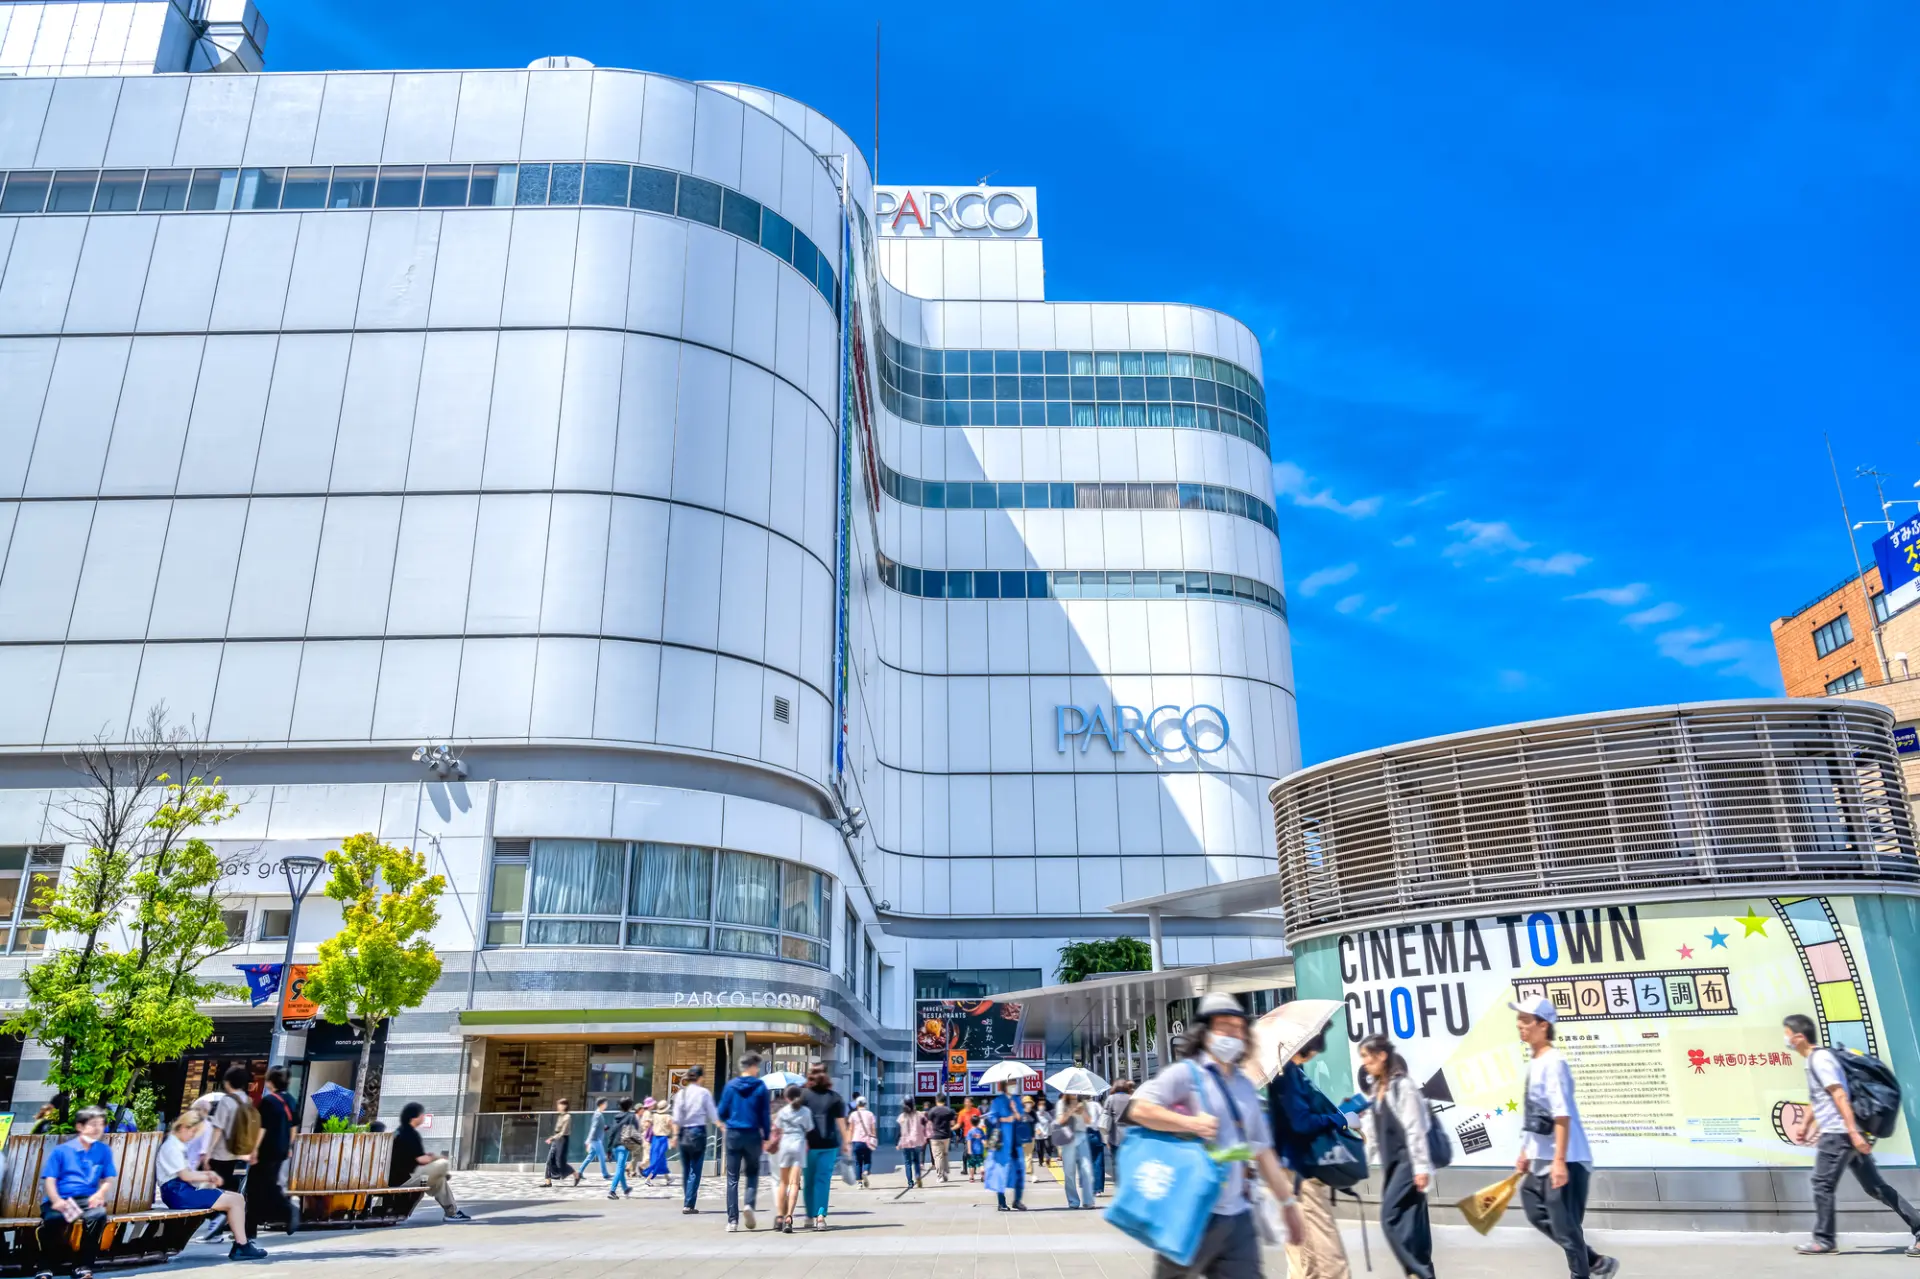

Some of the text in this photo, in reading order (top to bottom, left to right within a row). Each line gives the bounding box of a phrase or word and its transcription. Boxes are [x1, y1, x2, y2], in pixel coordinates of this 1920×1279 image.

[873, 189, 1028, 232] PARCO
[1055, 703, 1230, 756] PARCO
[1338, 905, 1646, 984] CINEMA TOWN
[674, 991, 745, 1007] PARCO
[1345, 982, 1470, 1042] CHOFU
[1173, 1023, 1183, 1033] 13
[1713, 1051, 1793, 1067] 映画のまち調布
[1025, 1080, 1042, 1089] QLO
